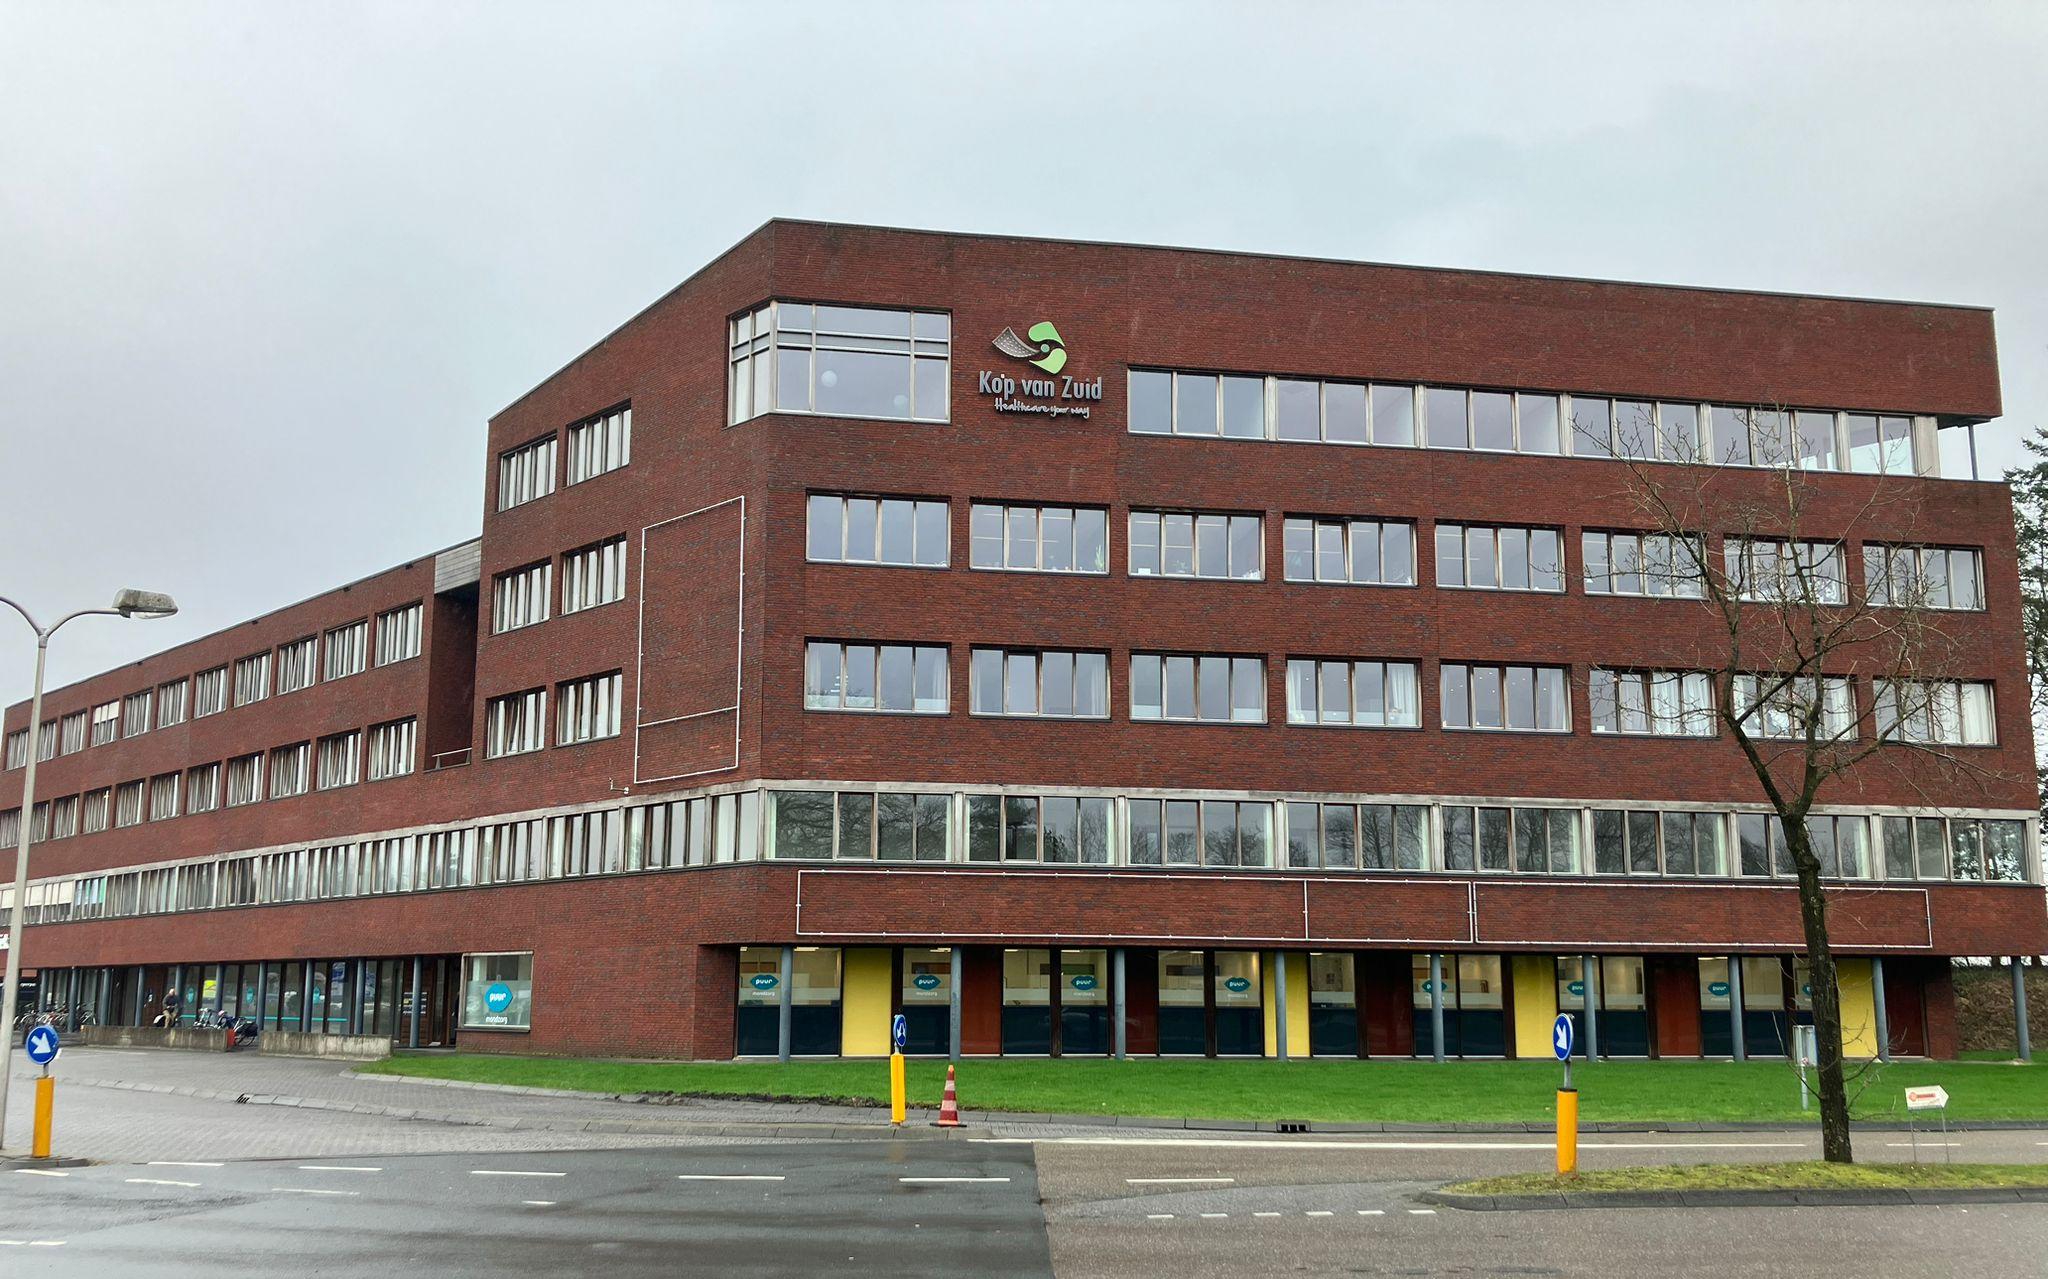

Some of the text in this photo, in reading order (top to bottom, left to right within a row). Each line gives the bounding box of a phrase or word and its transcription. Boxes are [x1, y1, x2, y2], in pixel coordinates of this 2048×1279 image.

[979, 370, 1102, 400] Kop van Zuid
[994, 397, 1090, 419] Healthcare your way
[489, 992, 507, 1003] puur
